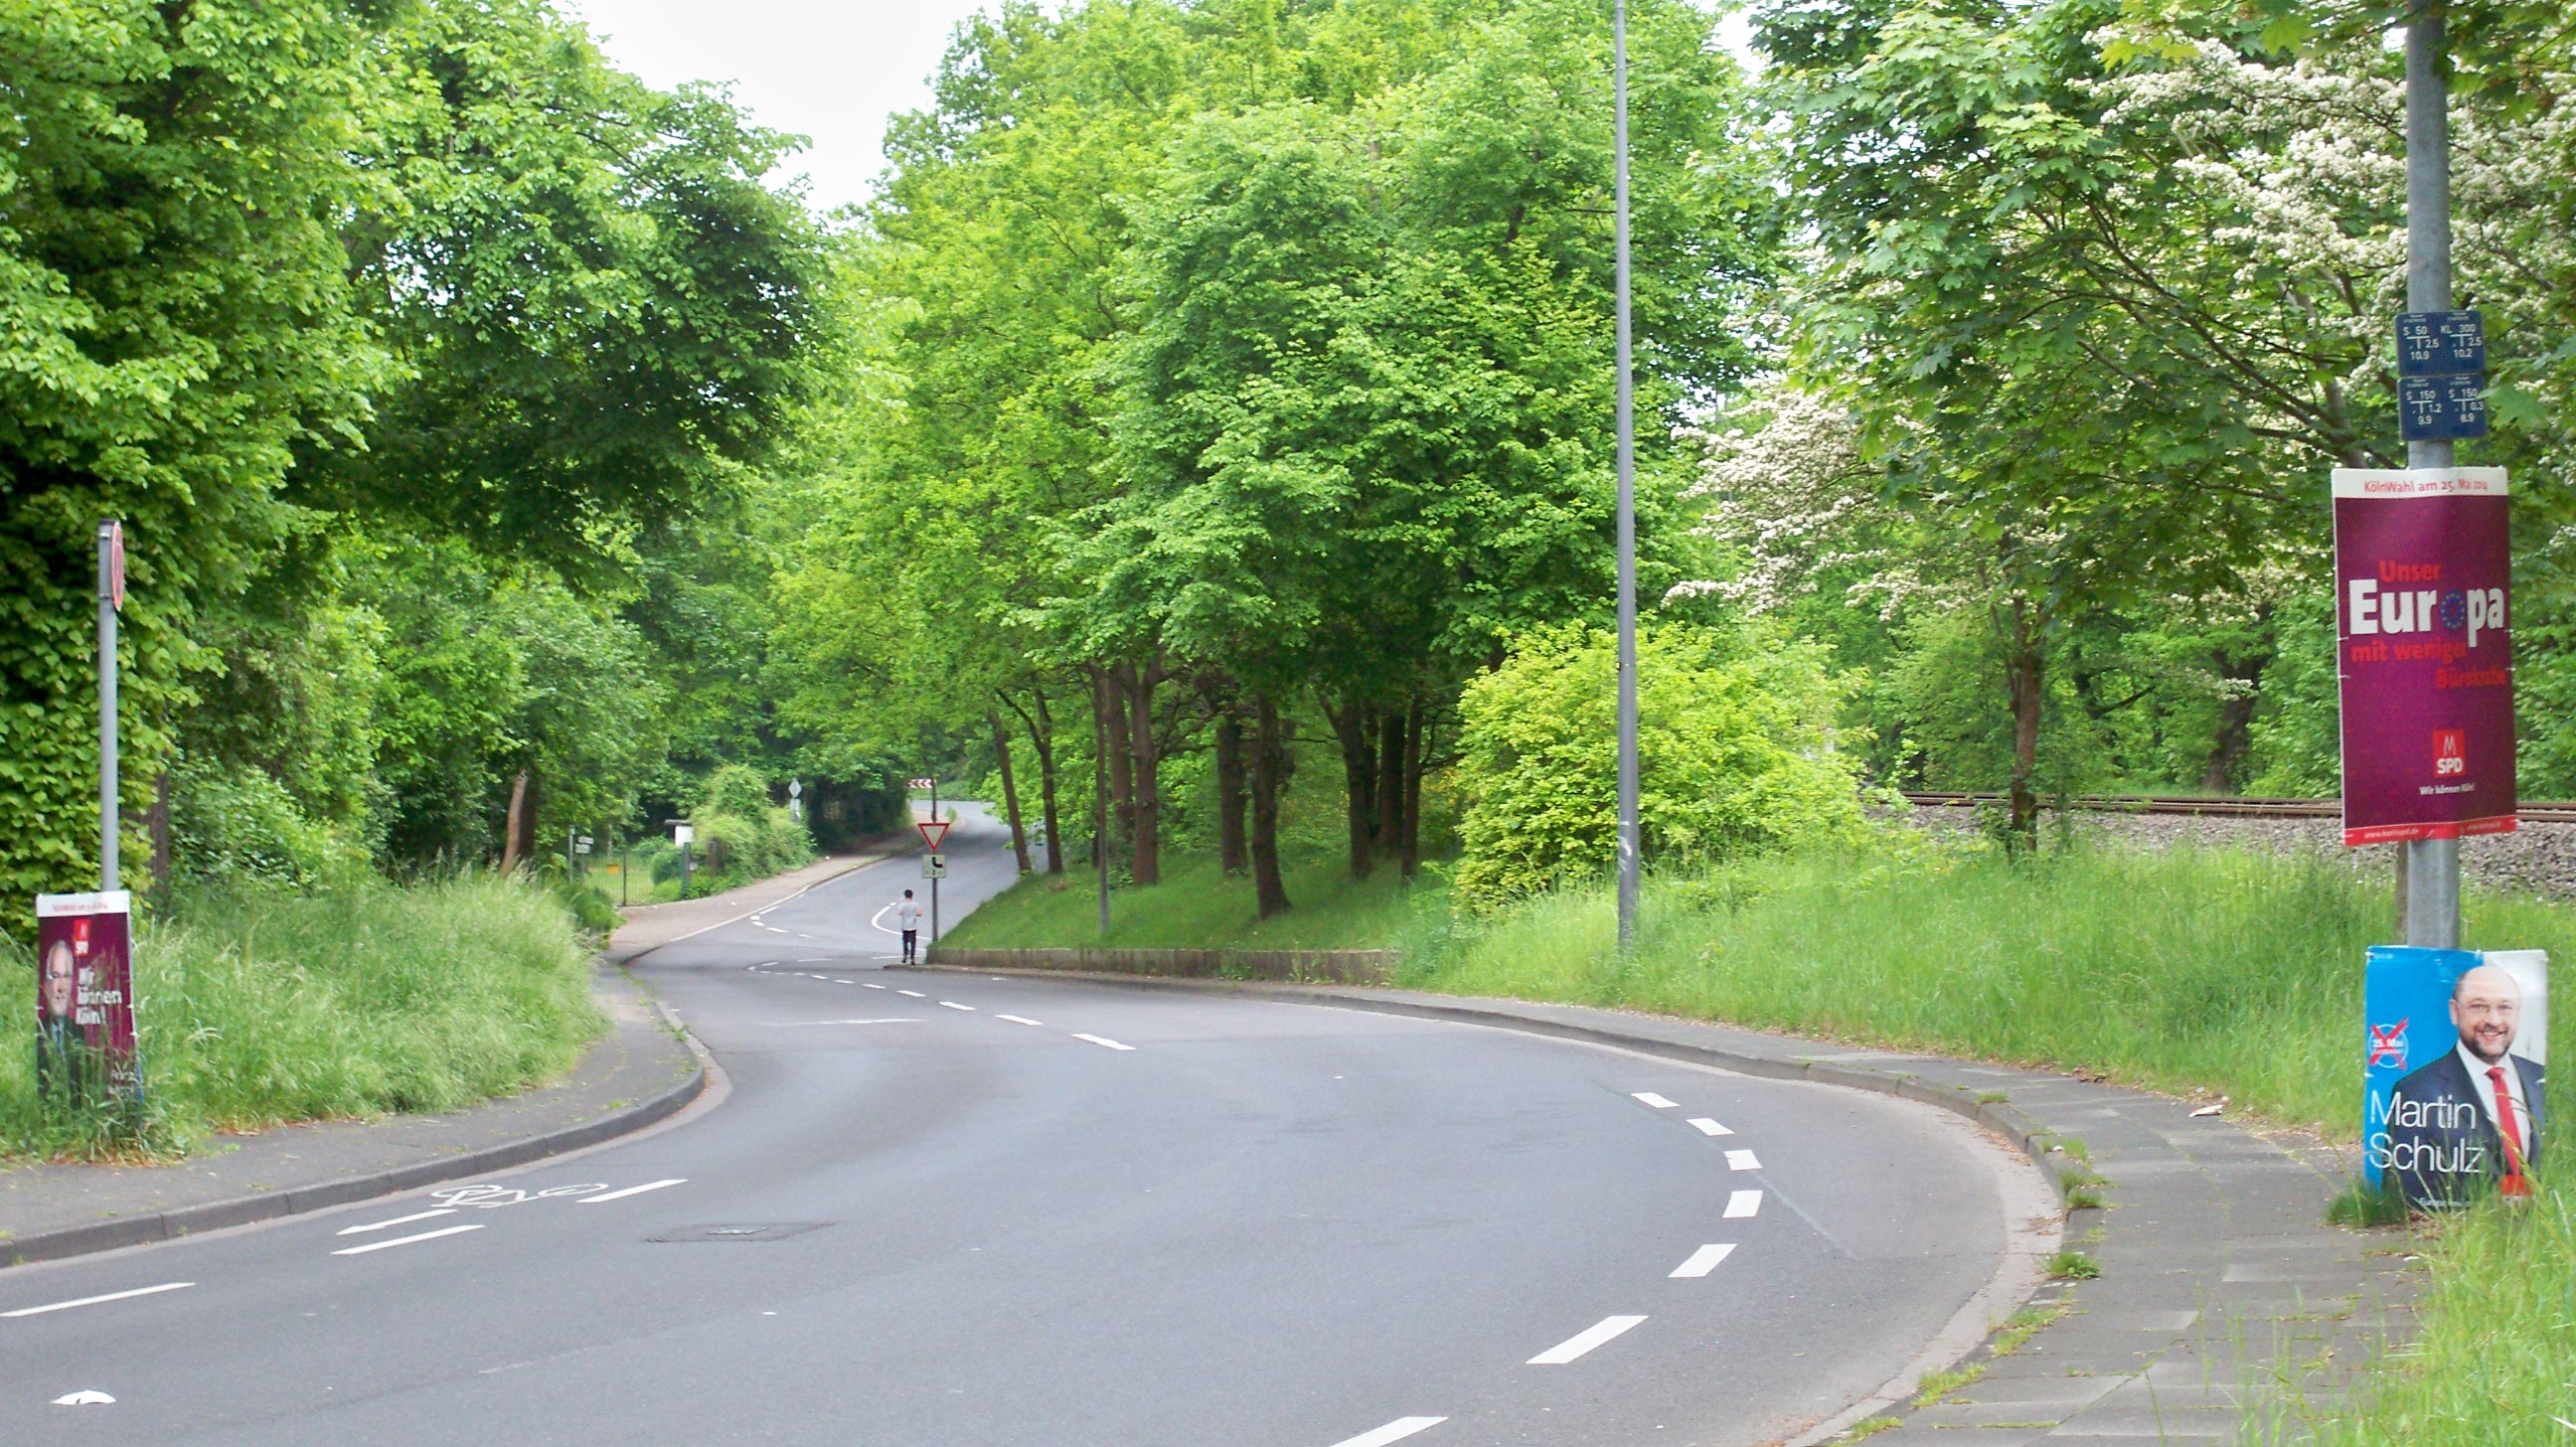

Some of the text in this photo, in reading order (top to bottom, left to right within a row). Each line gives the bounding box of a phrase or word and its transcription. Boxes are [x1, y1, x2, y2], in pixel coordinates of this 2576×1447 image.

[2403, 325, 2428, 336] S 50
[2459, 323, 2477, 333] 300
[2406, 390, 2436, 401] S 150
[2448, 388, 2478, 399] S 150
[2418, 481, 2438, 492] am
[2378, 560, 2441, 582] Unser
[2348, 579, 2504, 648] Europa
[2351, 636, 2467, 665] mit weniger
[2437, 757, 2463, 774] SPD
[2369, 1090, 2477, 1130] Martin
[2368, 1132, 2485, 1174] Schulz
